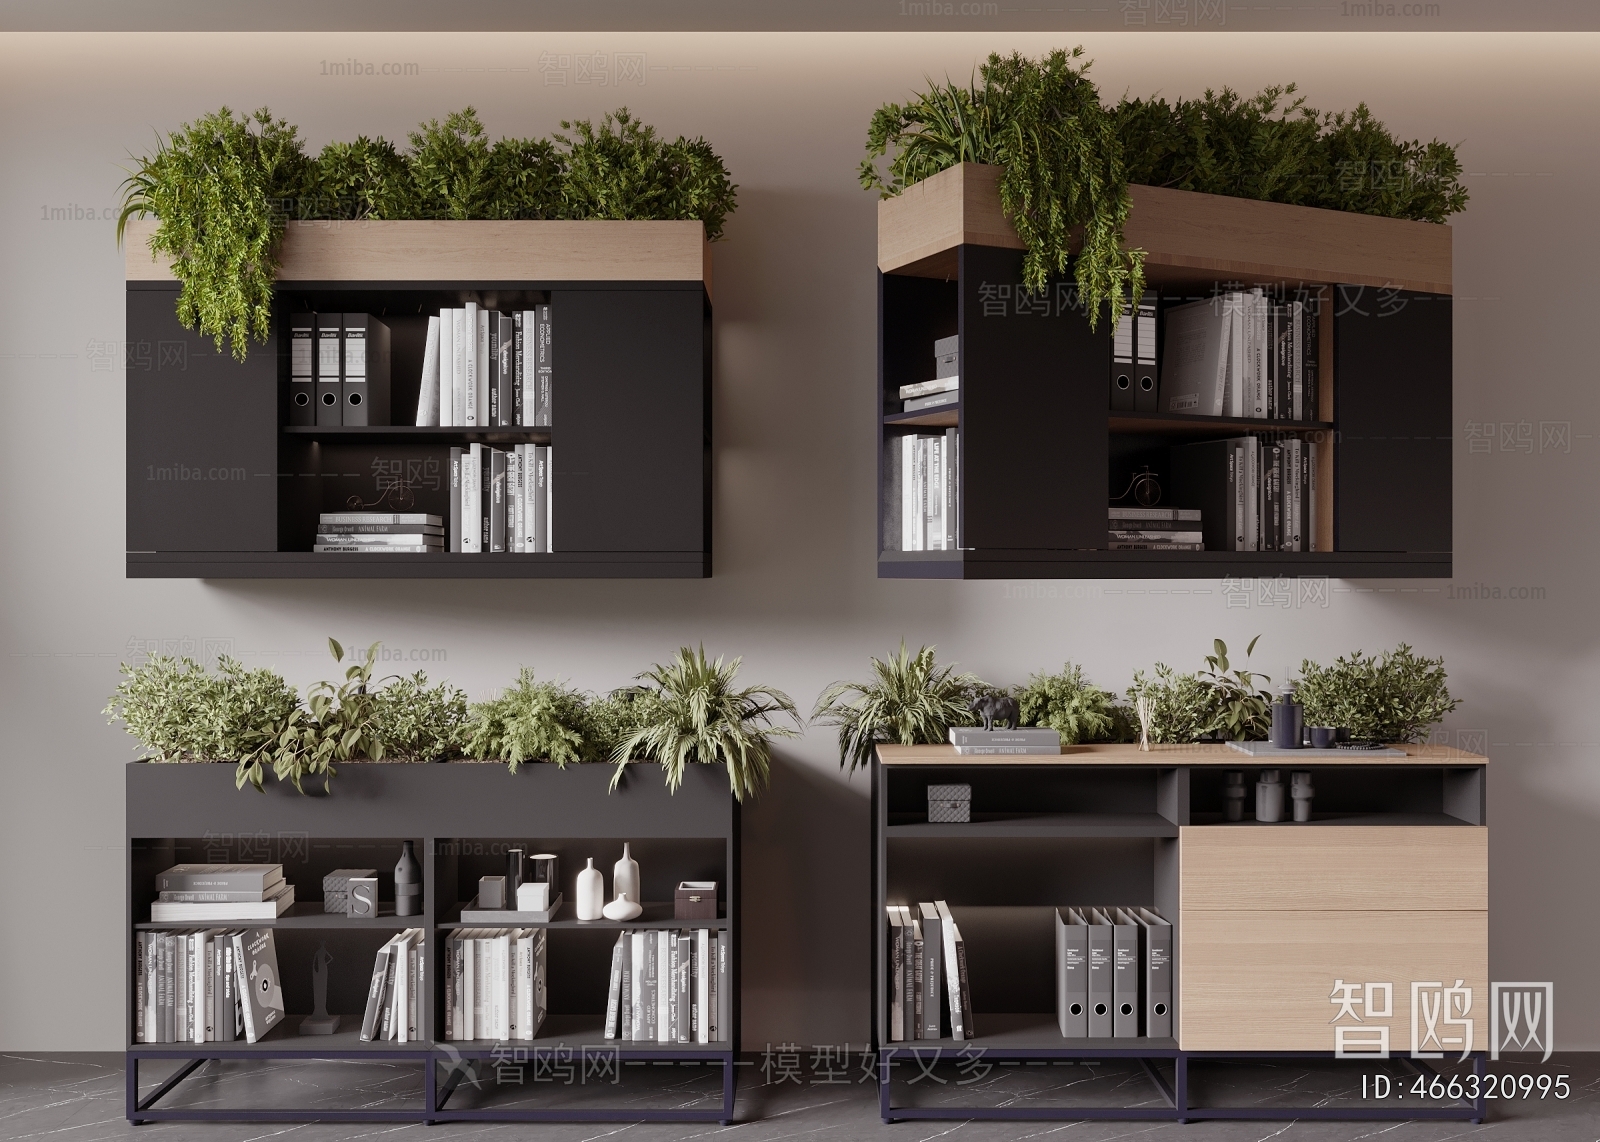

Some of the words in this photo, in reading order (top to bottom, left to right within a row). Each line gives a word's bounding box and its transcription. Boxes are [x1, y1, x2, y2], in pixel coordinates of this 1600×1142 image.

[934, 454, 939, 463] AT
[352, 884, 372, 915] S
[247, 932, 270, 951] CLOCKWORK
[252, 942, 266, 956] ORANGE
